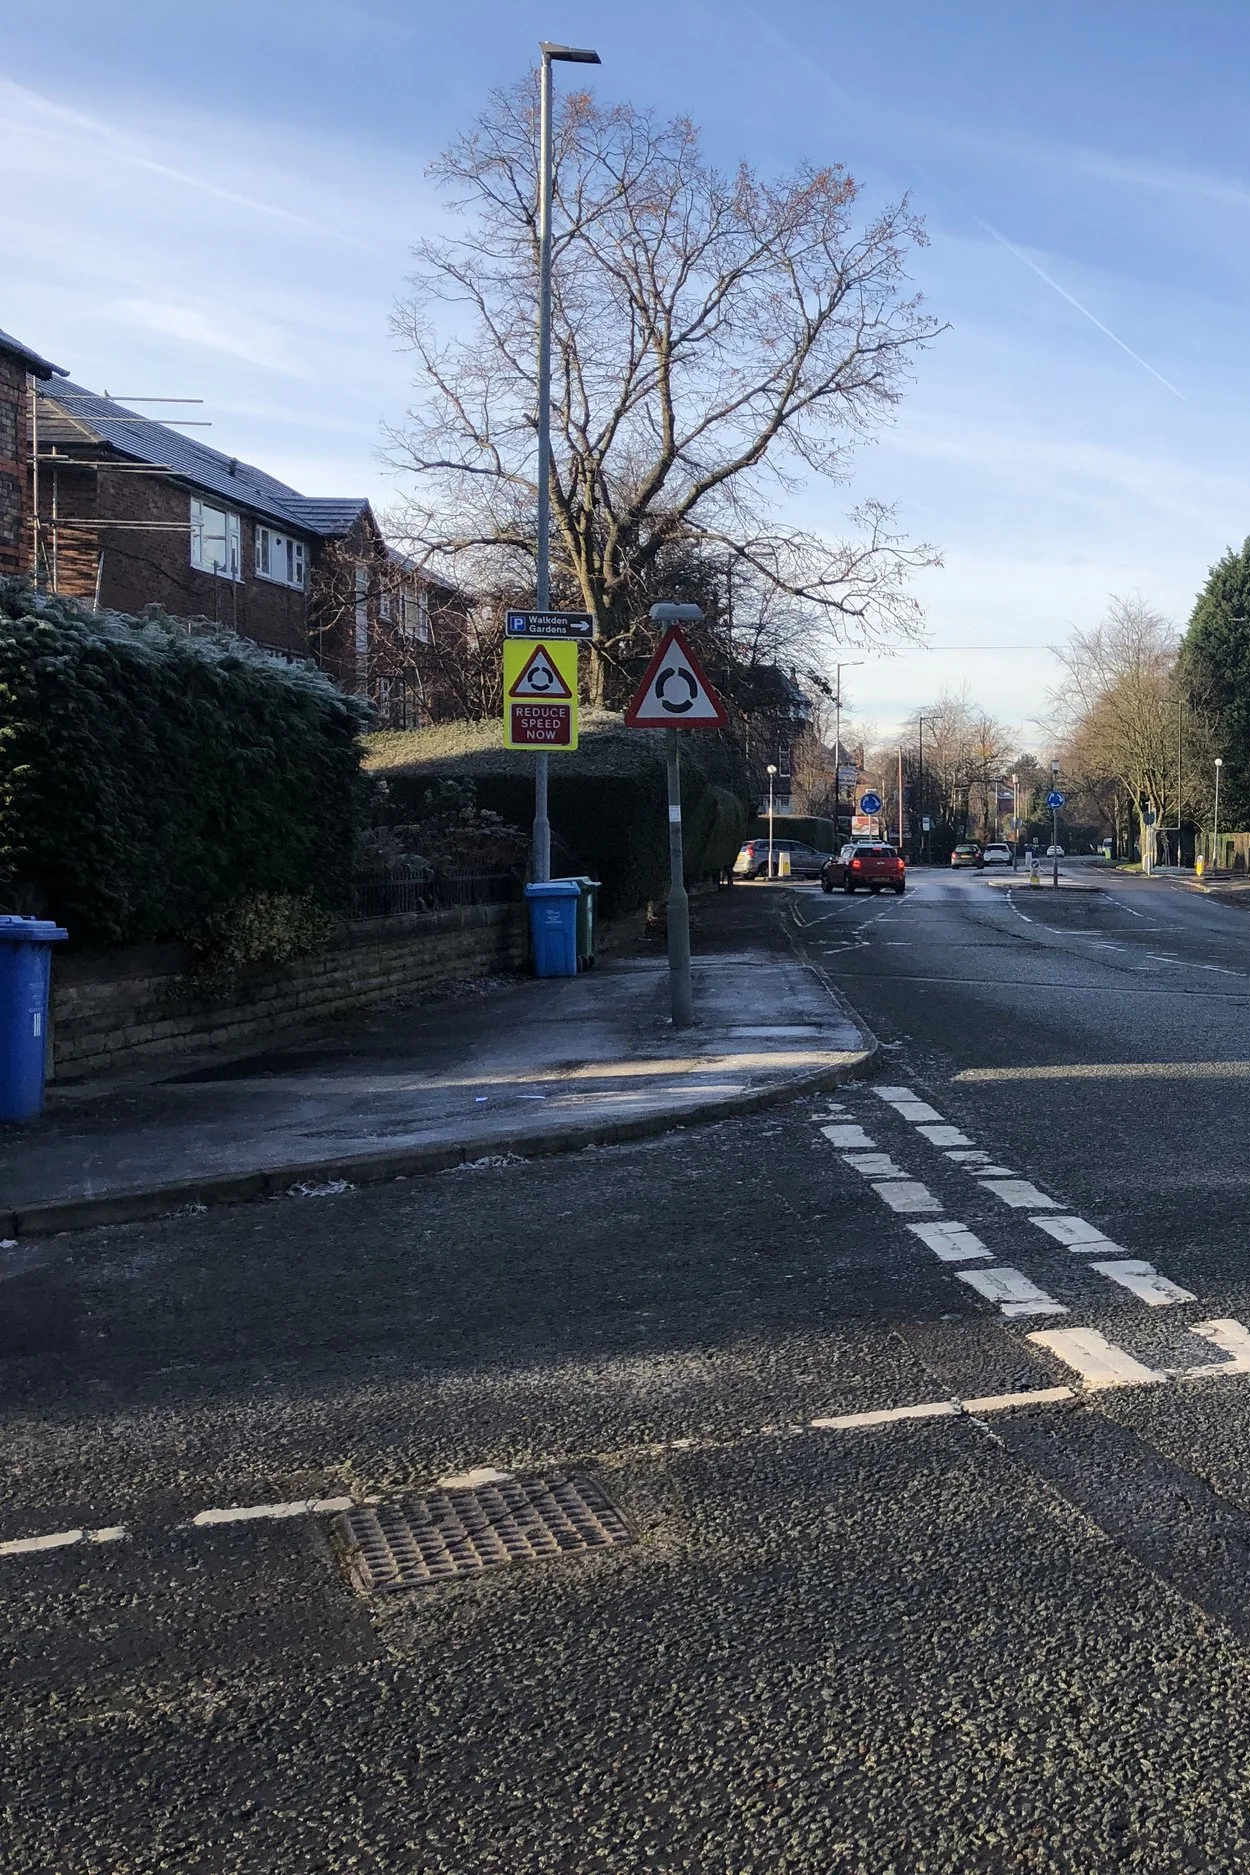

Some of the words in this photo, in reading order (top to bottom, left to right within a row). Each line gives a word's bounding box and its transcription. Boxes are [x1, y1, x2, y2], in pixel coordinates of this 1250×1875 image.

[528, 615, 568, 625] Walkden
[528, 625, 567, 634] Gardens
[515, 707, 566, 718] REDUCE
[521, 718, 561, 728] SPEED
[526, 730, 556, 740] NOW
